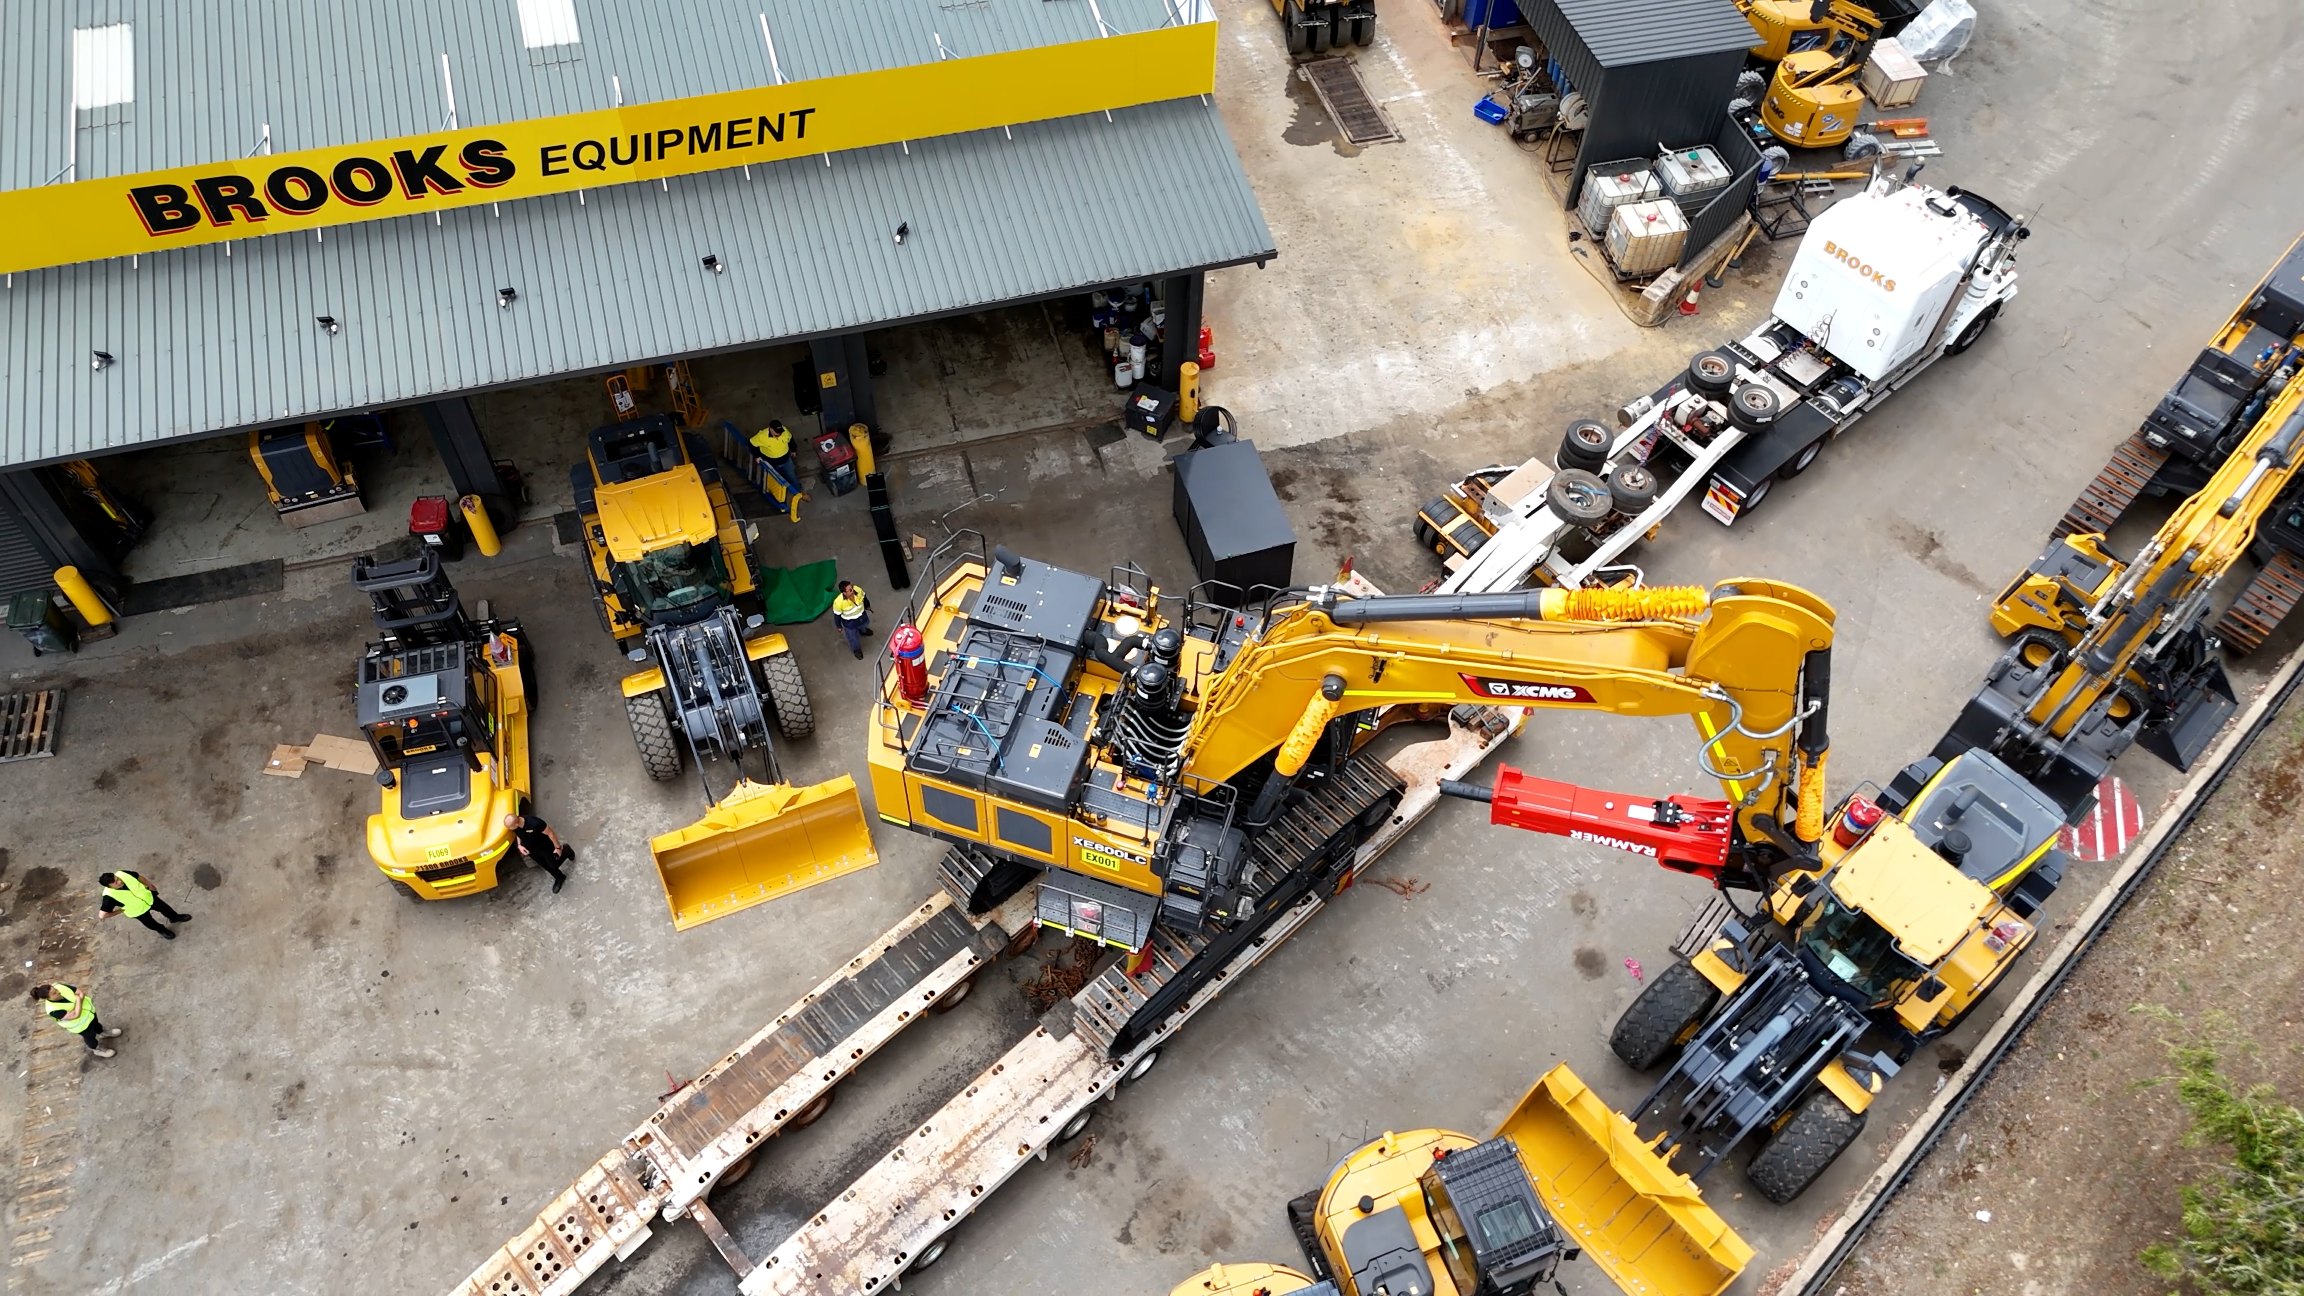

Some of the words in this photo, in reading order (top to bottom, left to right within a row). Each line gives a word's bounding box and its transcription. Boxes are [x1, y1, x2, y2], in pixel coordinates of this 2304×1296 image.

[127, 139, 516, 237] BROOKS
[540, 108, 816, 176] EQUIPMENT
[1823, 240, 1897, 292] BROOKS
[1511, 684, 1577, 699] XCMG
[1569, 829, 1657, 857] RAMMER
[428, 848, 449, 860] FL069
[440, 856, 469, 868] BROOKS
[1086, 852, 1116, 868] EX001
